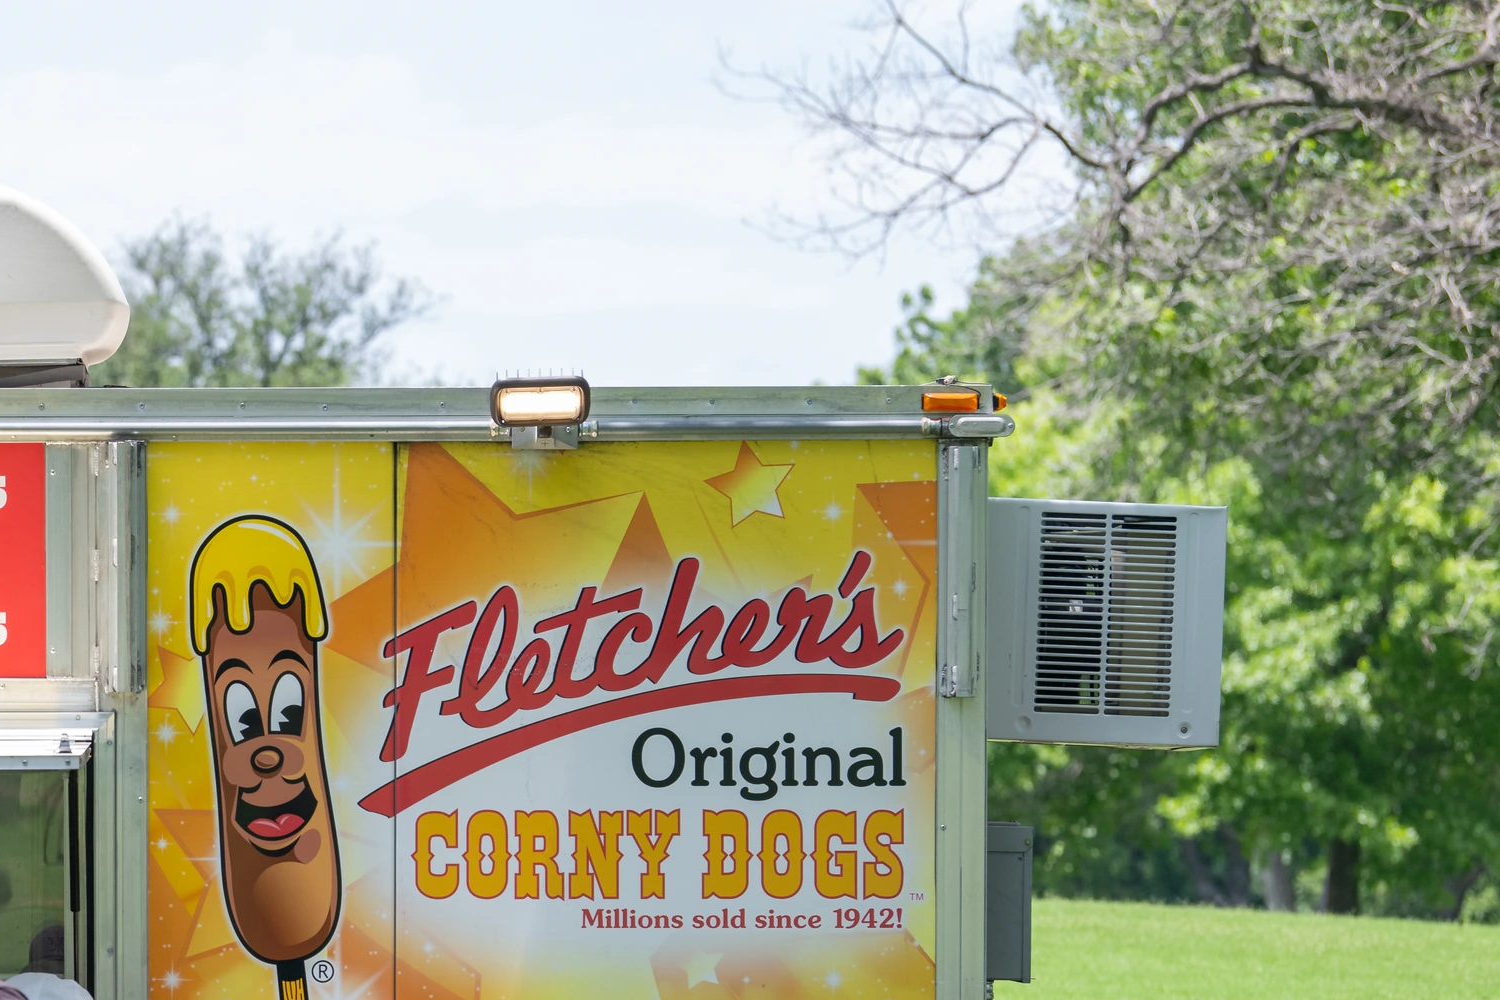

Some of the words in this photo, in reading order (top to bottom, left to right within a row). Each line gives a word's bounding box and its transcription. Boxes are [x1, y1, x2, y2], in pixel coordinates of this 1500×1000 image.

[379, 550, 904, 762] Fletcher's
[631, 726, 906, 801] Original
[411, 808, 681, 900] CORNY
[702, 808, 905, 900] DOGS
[581, 908, 684, 929] Millions
[692, 908, 746, 929] sold
[755, 908, 822, 929] since
[833, 908, 904, 929] 1942!
